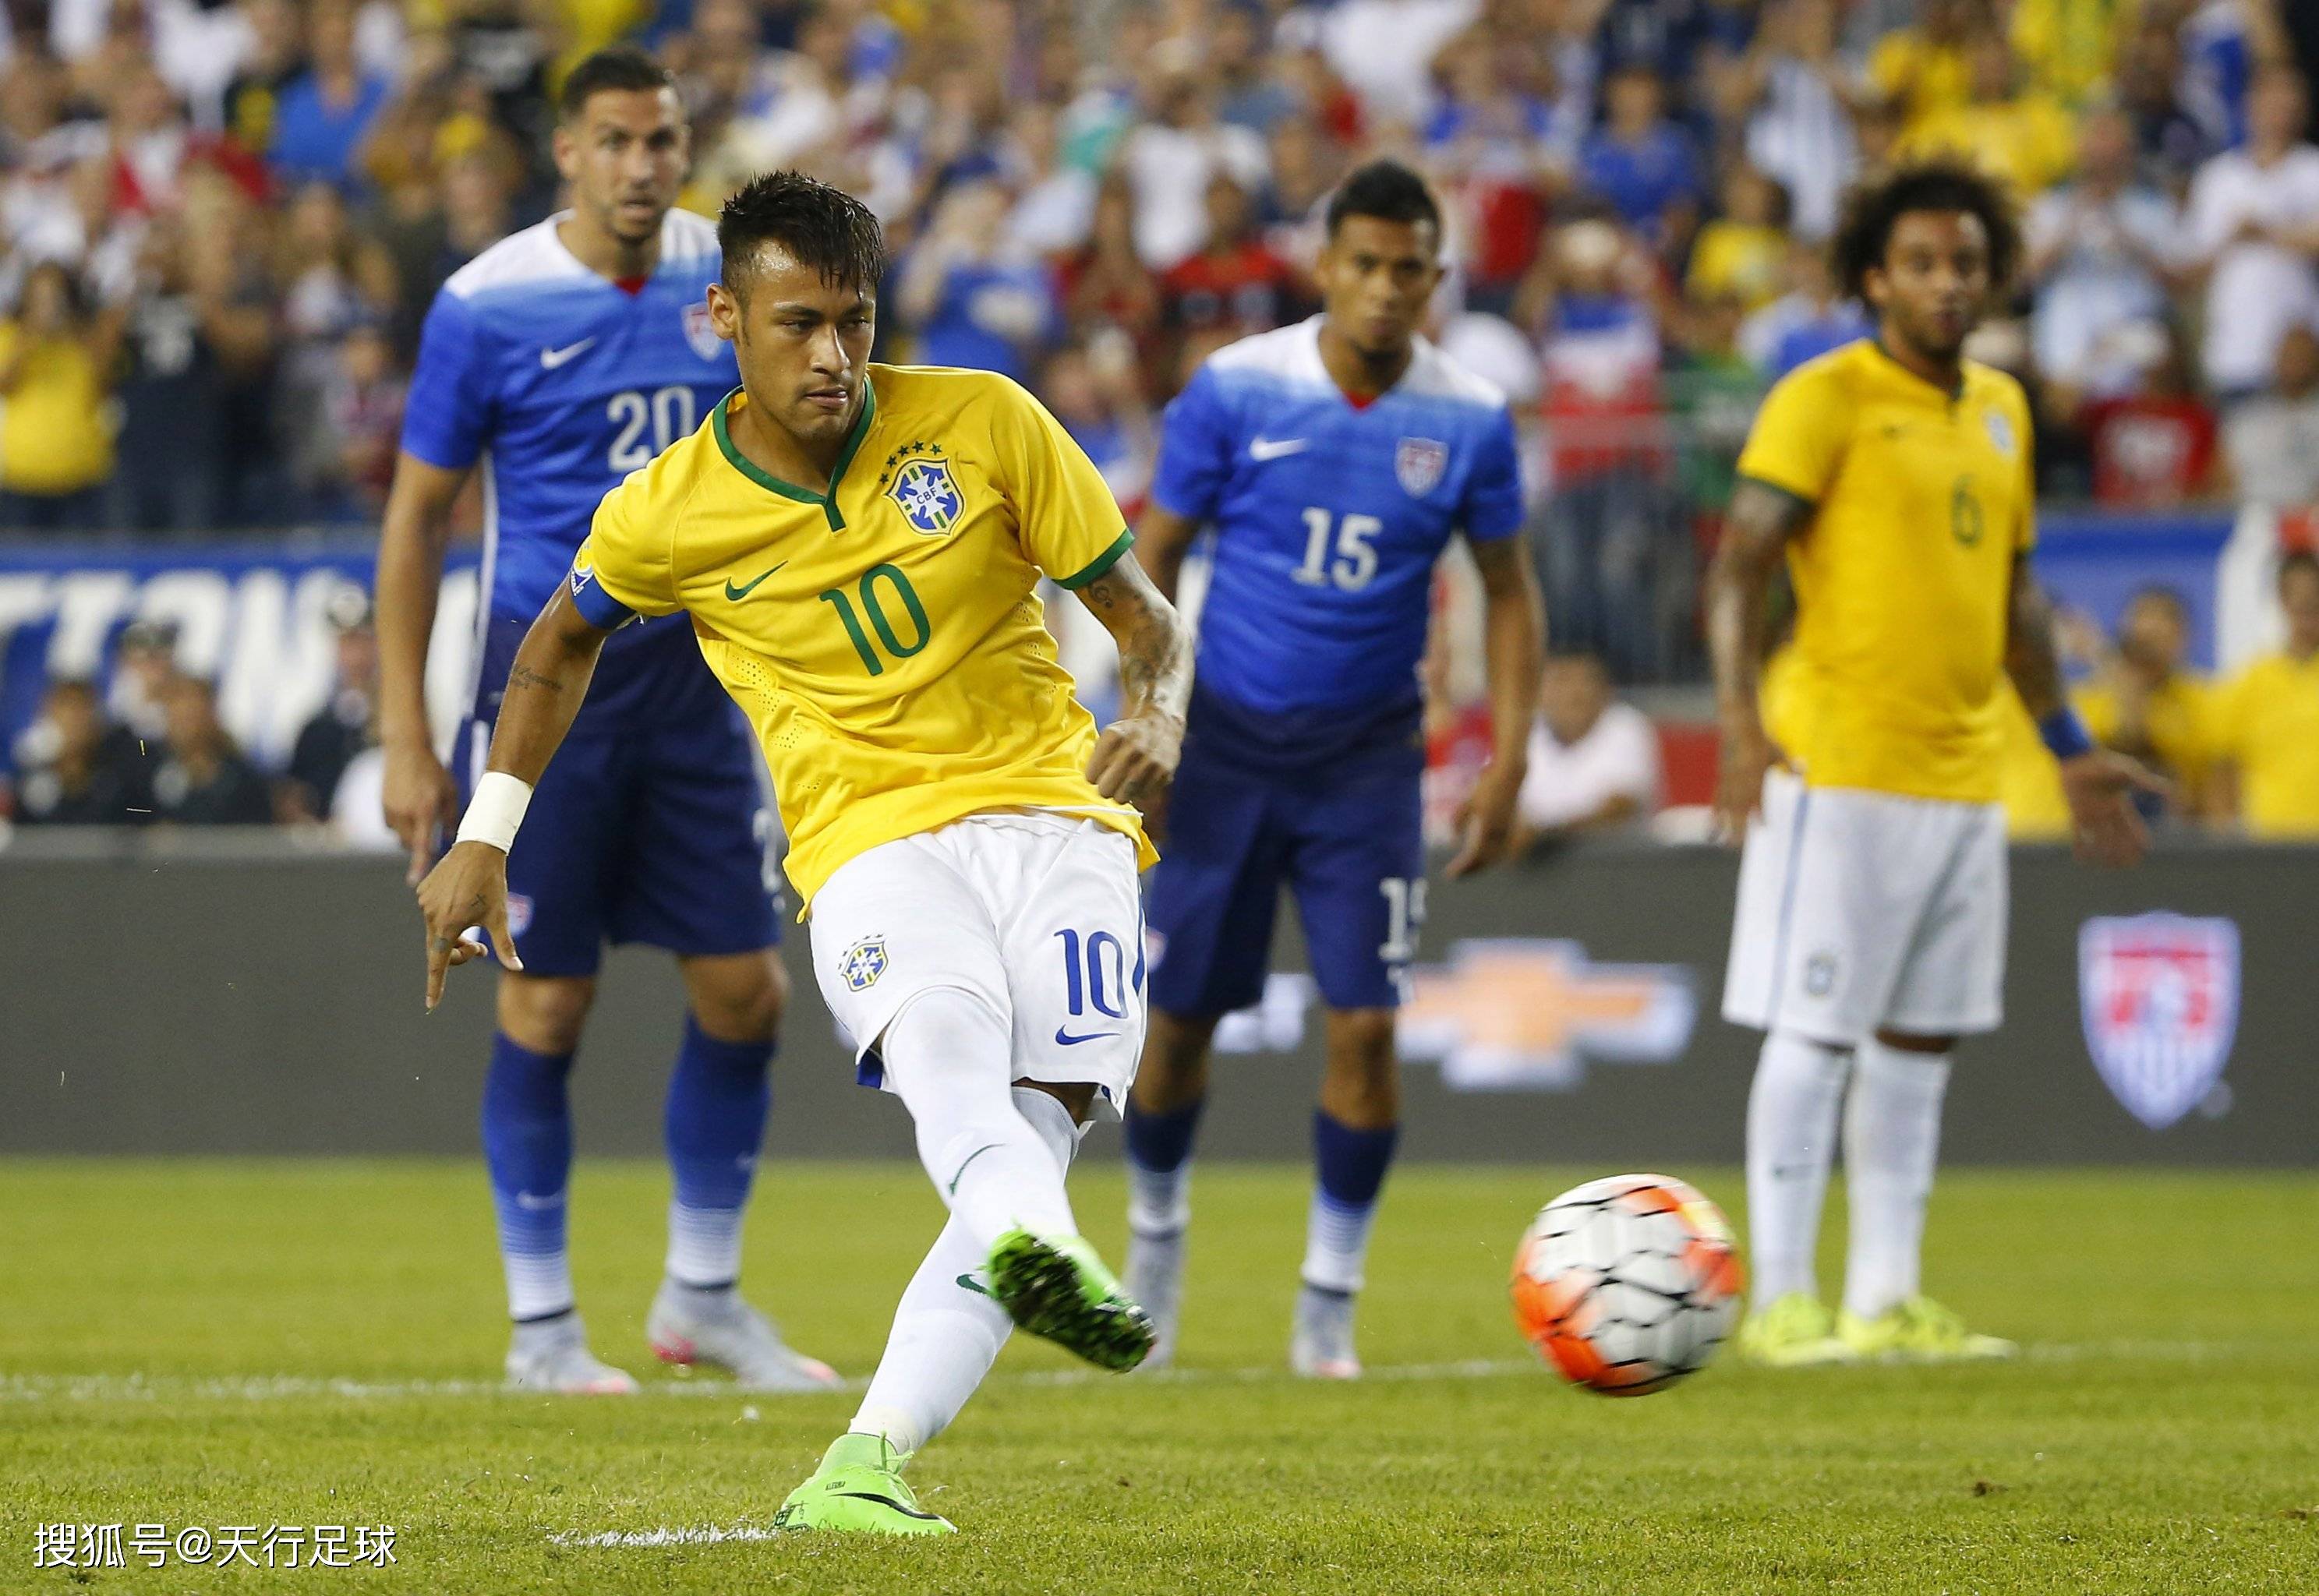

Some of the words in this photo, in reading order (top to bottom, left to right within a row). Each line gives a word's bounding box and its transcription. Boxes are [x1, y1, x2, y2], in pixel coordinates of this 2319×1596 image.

[606, 386, 695, 472] 20
[916, 486, 938, 504] CBF
[1950, 471, 1985, 547] 6
[1290, 507, 1383, 592] 15
[819, 563, 931, 676] 10
[1054, 928, 1128, 1019] 10
